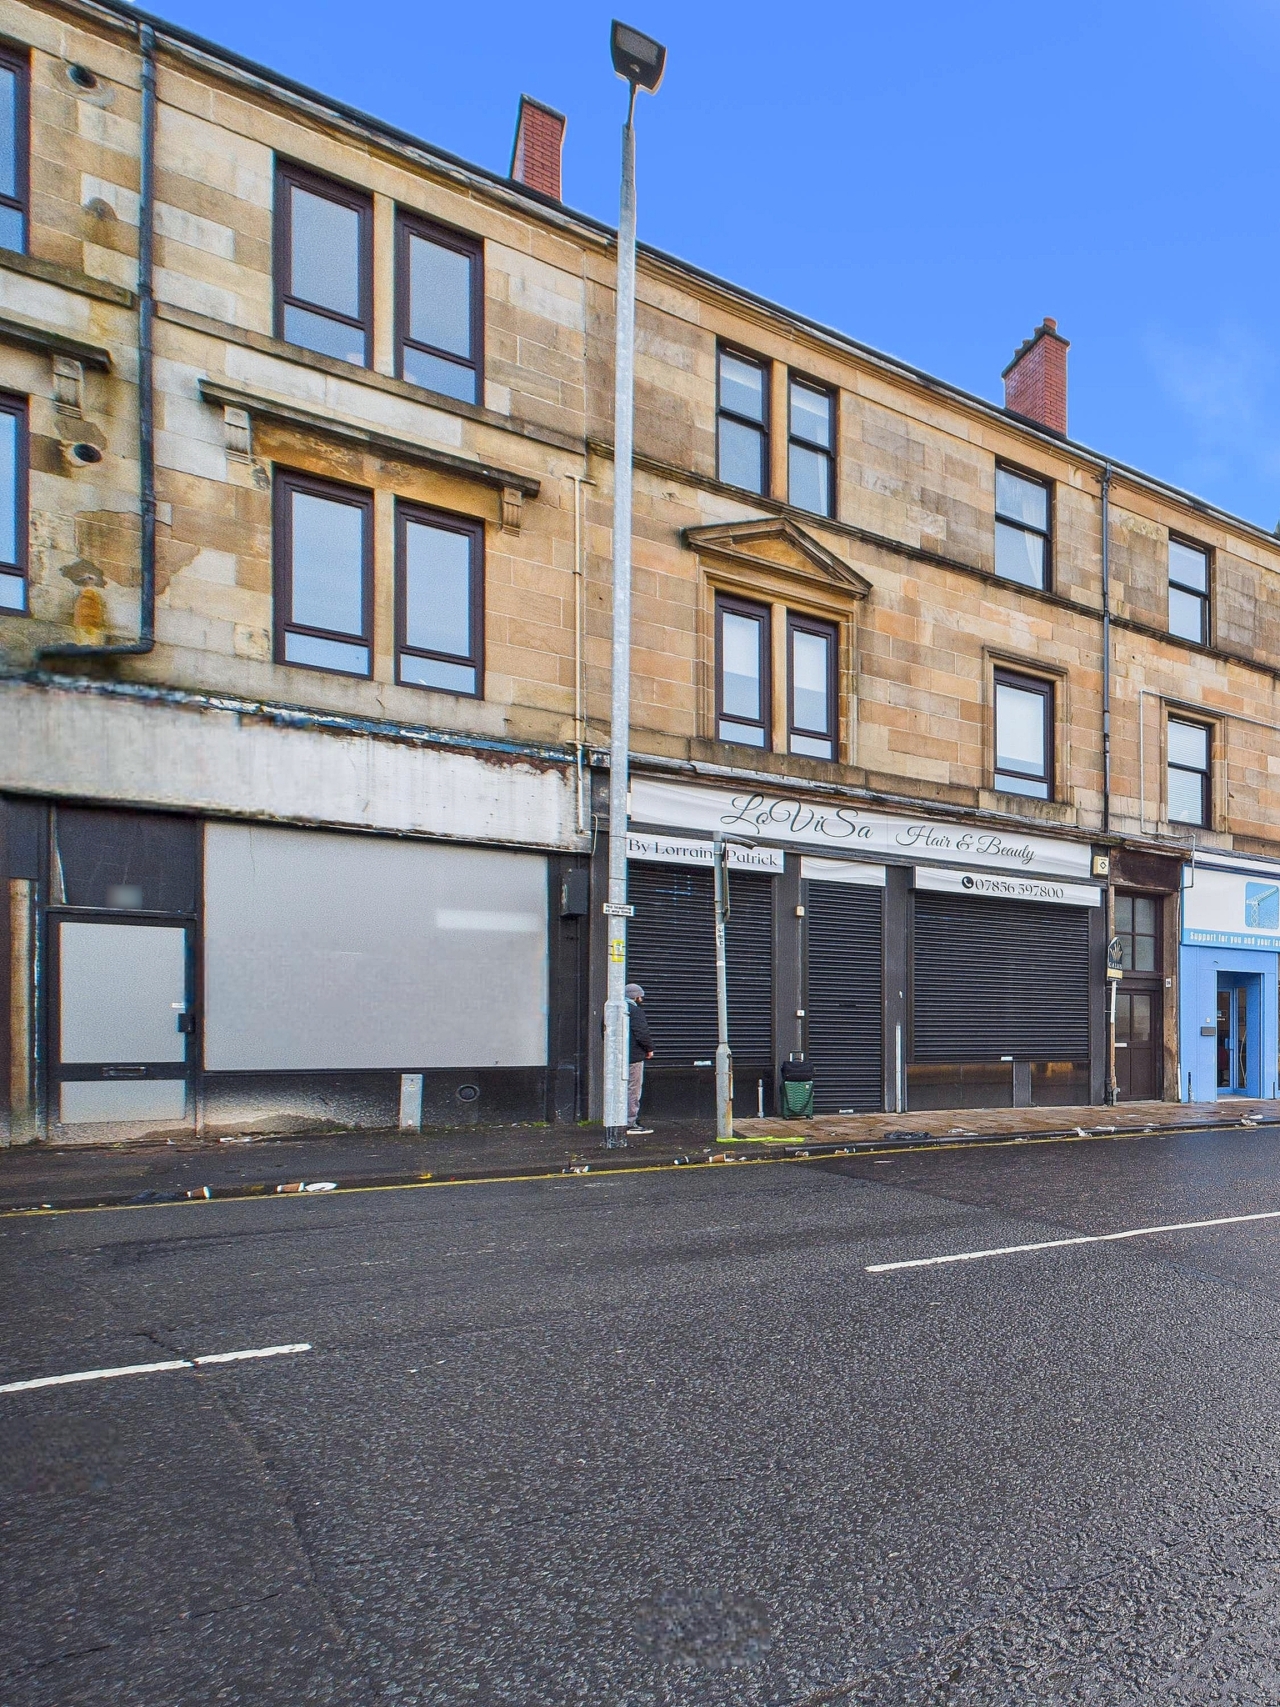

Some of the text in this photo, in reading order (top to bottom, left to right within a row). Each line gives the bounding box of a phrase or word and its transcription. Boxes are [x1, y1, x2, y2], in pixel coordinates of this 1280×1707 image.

[720, 793, 1036, 865] LoViSa Hair & Beauty
[629, 838, 778, 867] By Lorrain Patrick
[975, 878, 1064, 899] 07856 597800
[1190, 931, 1216, 942] Support
[1218, 934, 1228, 942] for
[1230, 935, 1241, 944] you
[1243, 937, 1255, 945] and
[1257, 938, 1271, 946] your
